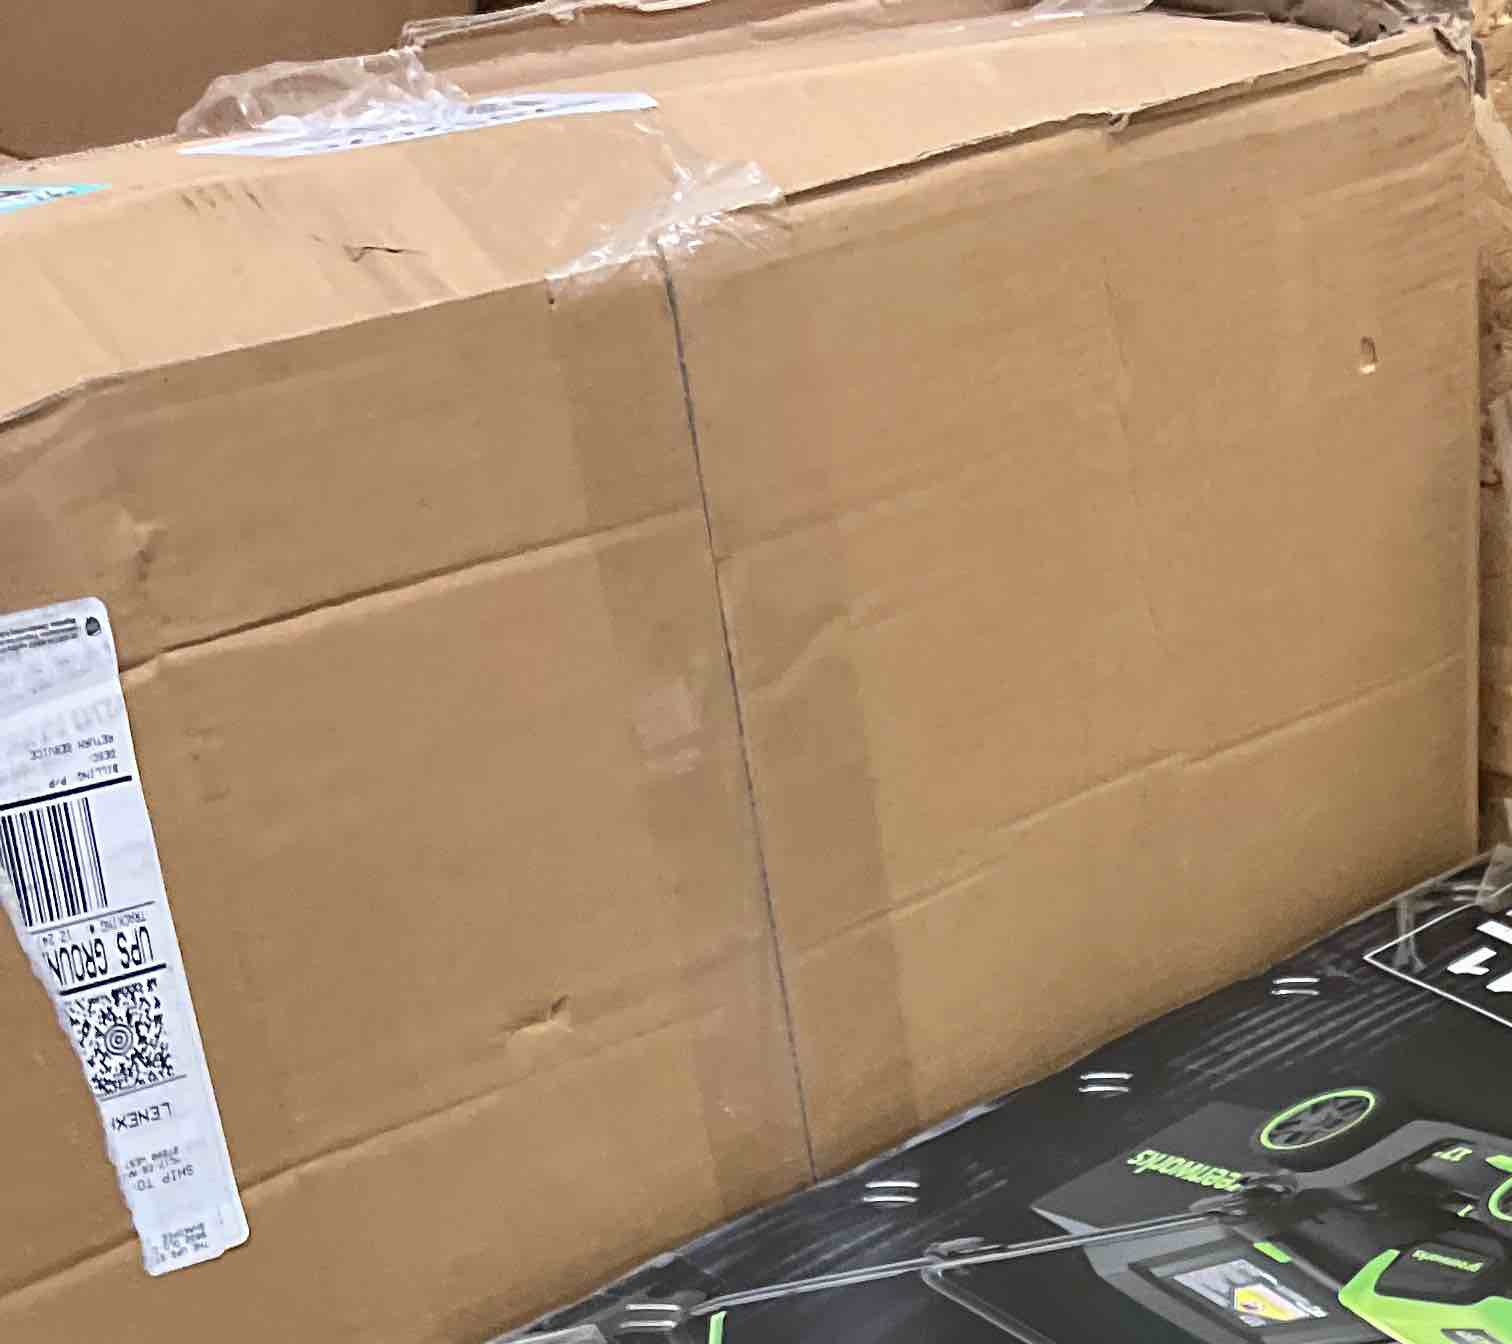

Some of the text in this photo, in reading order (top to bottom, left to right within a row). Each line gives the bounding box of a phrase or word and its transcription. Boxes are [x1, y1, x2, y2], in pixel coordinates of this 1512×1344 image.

[43, 925, 153, 986] UPS GROUN
[160, 1163, 193, 1183] SHIP
